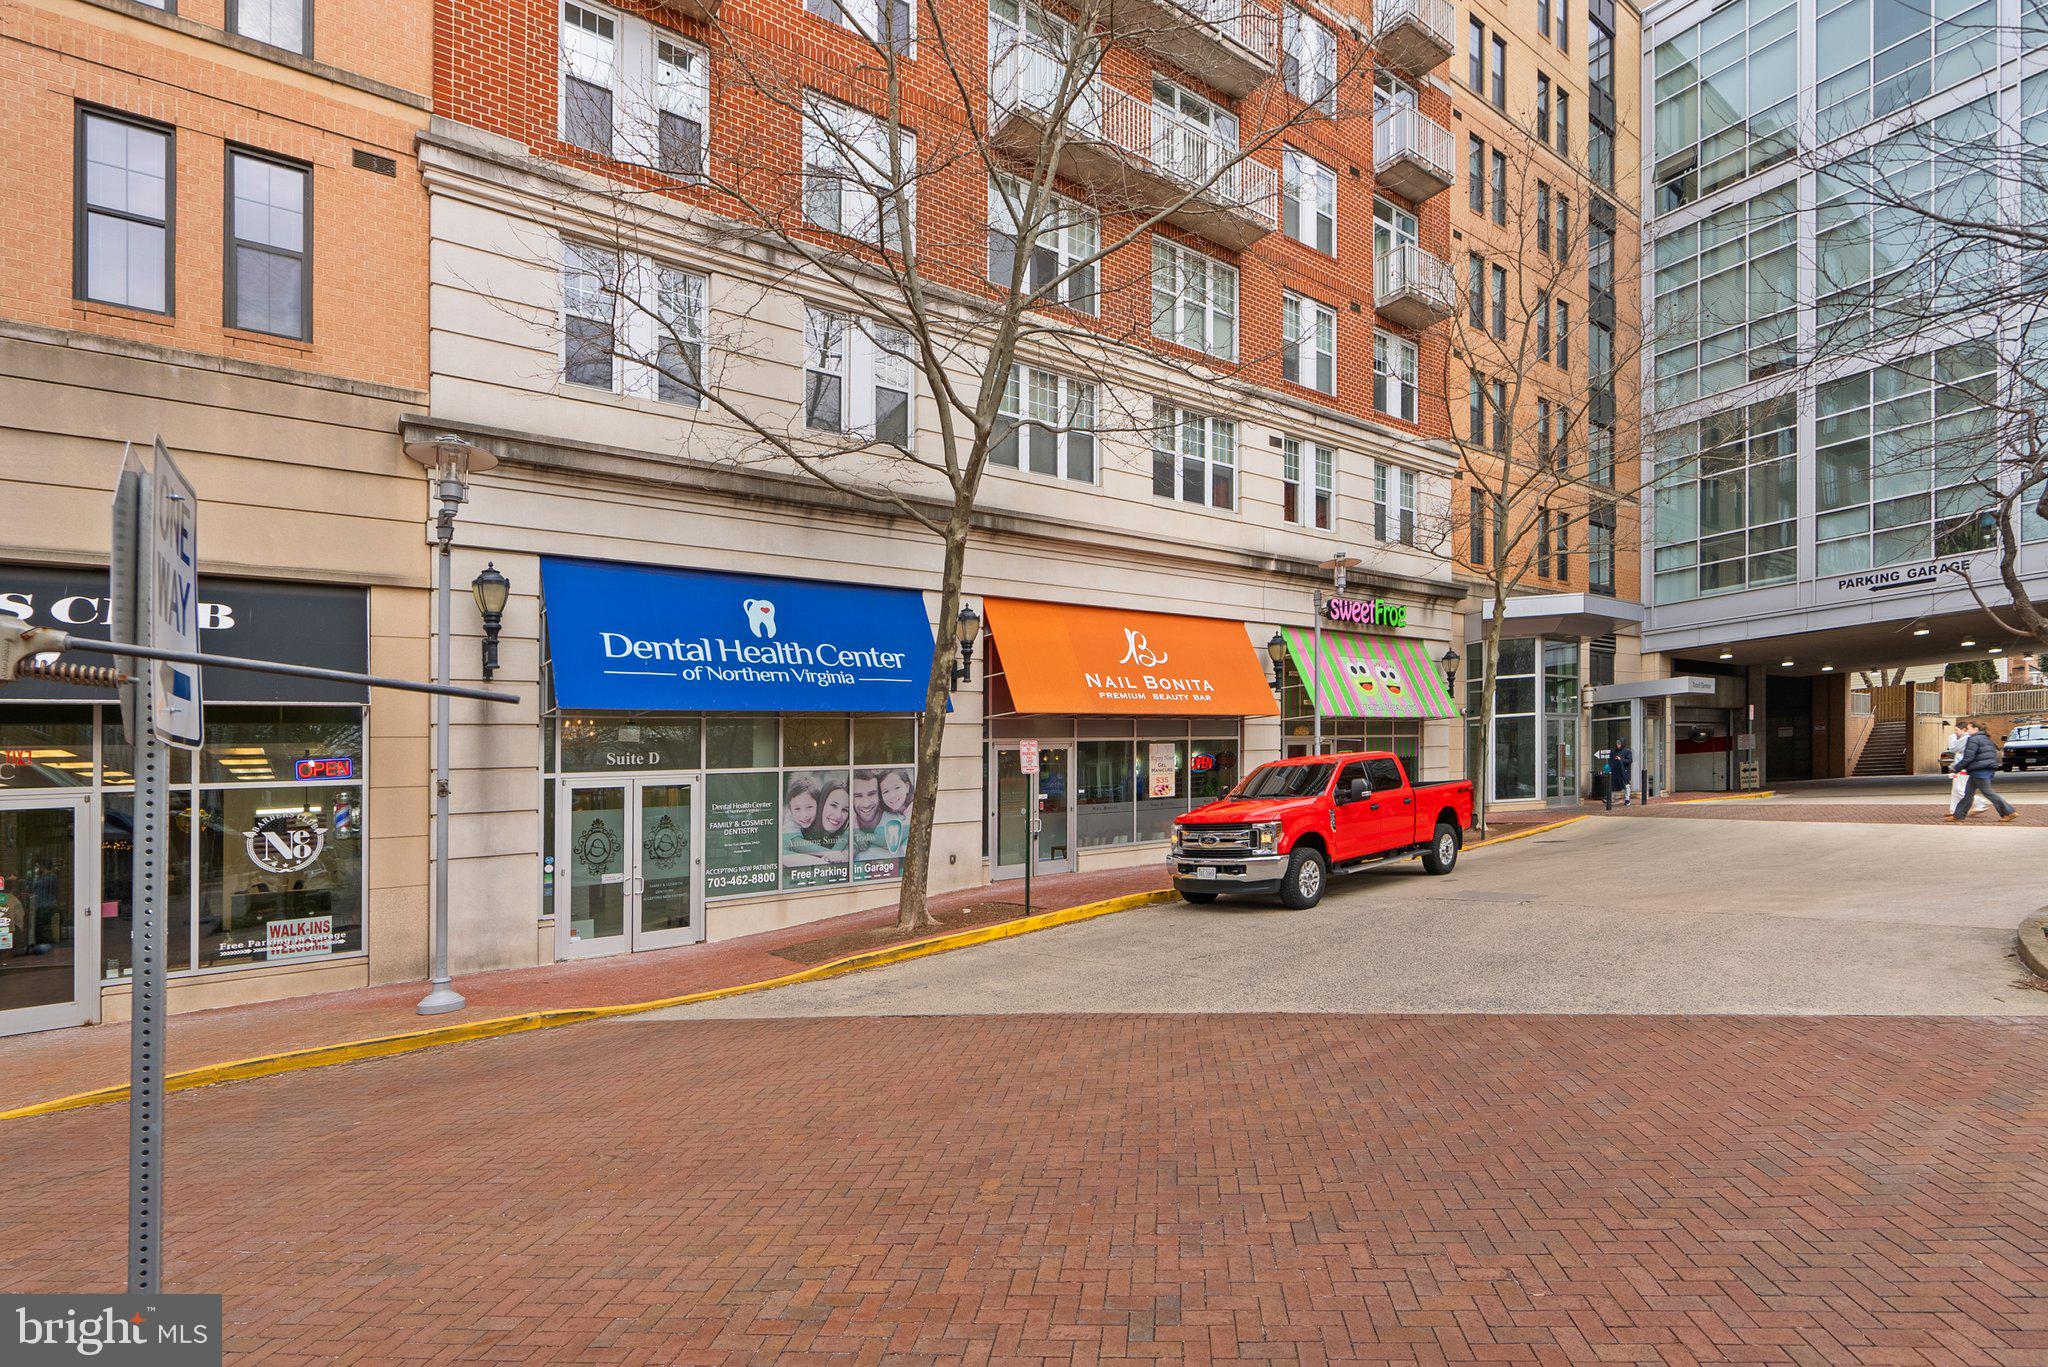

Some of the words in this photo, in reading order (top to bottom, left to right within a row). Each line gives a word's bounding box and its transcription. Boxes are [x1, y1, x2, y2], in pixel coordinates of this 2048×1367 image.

[159, 475, 190, 567] ONE
[1839, 571, 1900, 590] PARKING
[1907, 560, 1970, 578] GARAGE
[157, 551, 190, 636] WAY
[599, 632, 712, 661] Dental
[715, 638, 813, 665] Health
[816, 643, 905, 668] Center
[682, 666, 703, 681] of
[705, 666, 790, 683] Northern
[790, 668, 855, 687] Virginia
[1084, 673, 1137, 689] NAIL
[1142, 675, 1214, 691] BONITA
[1098, 692, 1146, 700] PREMIUM
[1152, 693, 1189, 701] BEAUTY
[606, 752, 644, 765] Suite
[648, 752, 660, 764] D
[298, 761, 349, 778] OPEN
[712, 803, 732, 811] Dental
[733, 802, 751, 810] Health
[252, 813, 295, 833] BARBERS
[297, 813, 318, 830] CLUB
[709, 821, 733, 829] FAMILY
[741, 818, 774, 827] COSMETIC
[724, 827, 759, 835] DENTISTRY
[706, 867, 738, 875] ACCEPTING
[738, 865, 752, 873] NEW
[753, 863, 778, 871] PATIENTS
[791, 870, 812, 880] Free
[814, 867, 847, 878] Parking
[854, 865, 862, 873] in
[864, 861, 894, 873] Garage
[707, 872, 775, 888] 703-462-8800
[269, 919, 330, 939] WALK-INS
[219, 941, 244, 951] Free
[247, 934, 294, 947] Parking
